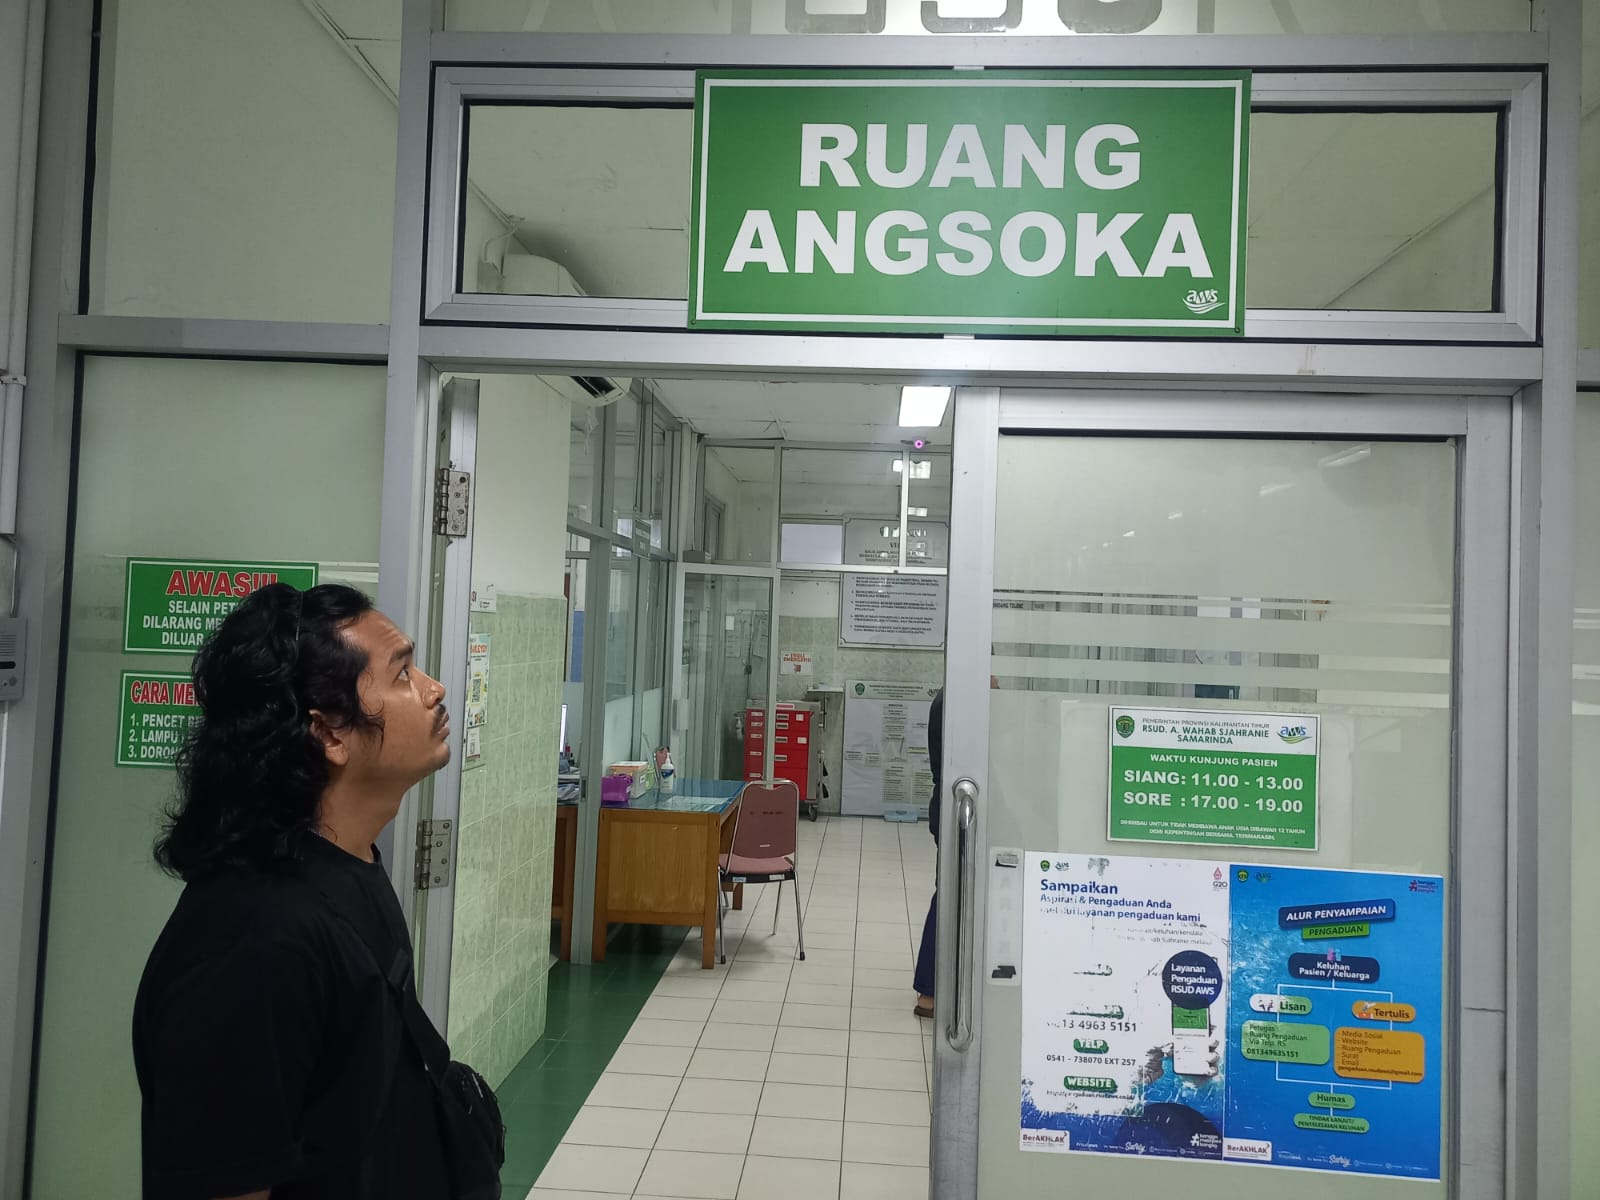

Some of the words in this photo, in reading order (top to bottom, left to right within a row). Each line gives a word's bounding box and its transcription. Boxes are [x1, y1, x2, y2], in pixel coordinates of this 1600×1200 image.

[799, 122, 1141, 190] RUANG
[722, 209, 1214, 279] ANGSOKA
[168, 600, 209, 615] SELAIN
[213, 602, 239, 615] PET
[143, 615, 201, 630] DILARANG
[205, 617, 223, 631] ME
[161, 632, 204, 646] DILUAR
[130, 680, 170, 705] CARA
[172, 682, 200, 707] ME
[130, 713, 140, 727] 1.
[142, 714, 185, 728] PENCET
[1142, 717, 1180, 725] PEMERINTAH
[1209, 720, 1250, 728] KALIMANTAN
[128, 729, 138, 742] 2.
[141, 730, 179, 744] LAMPU
[1142, 725, 1168, 733] RSUD.
[1170, 726, 1180, 734] A.
[1182, 726, 1217, 735] WAHAB
[1219, 728, 1270, 738] SJAHRANIE
[1177, 734, 1233, 744] SAMARINDA
[127, 745, 137, 758] 3.
[1150, 753, 1187, 763] WAKTU
[1190, 755, 1239, 766] KUNJUNG
[1242, 758, 1278, 767] PASIEN
[1123, 770, 1186, 785] SIANG:
[1191, 773, 1239, 787] 11.00
[1256, 777, 1303, 790] 13.00
[1123, 791, 1172, 806] SORE
[1191, 795, 1239, 810] 17.00
[1256, 798, 1303, 813] 19.00
[1040, 879, 1118, 895] Sampaikan
[1088, 896, 1144, 908] Pengaduan
[1146, 899, 1172, 909] Anda
[1117, 910, 1175, 921] pengaduan
[1176, 912, 1201, 922] kami
[1286, 910, 1313, 921] ALUR
[1314, 905, 1386, 919] PENYAMPAIAN
[1309, 924, 1364, 936] PENGADUAN
[1171, 963, 1206, 973] Layanan
[1316, 961, 1350, 971] Keluhan
[1171, 974, 1218, 985] Pengaduan
[1299, 967, 1326, 977] Pasien
[1333, 970, 1370, 980] Keluarga
[1171, 985, 1195, 994] RSUD
[1195, 986, 1215, 995] AWS
[1279, 1001, 1307, 1011] Lisan
[1374, 1007, 1410, 1018] Tertulis
[1078, 1020, 1106, 1030] 4963
[1110, 1022, 1137, 1032] 5151
[1249, 1023, 1275, 1032] Petugas
[1249, 1031, 1270, 1039] Ruang
[1271, 1033, 1308, 1041] Pengaduan
[1341, 1030, 1362, 1038] Media
[1079, 1039, 1104, 1049] TELP
[1341, 1044, 1363, 1053] Ruang
[1364, 1046, 1401, 1056] Pengaduan
[1046, 1054, 1065, 1062] 0541
[1073, 1056, 1102, 1065] 738070
[1104, 1057, 1119, 1065] EXT
[1121, 1058, 1136, 1066] 257
[1341, 1051, 1359, 1059] Surat
[1067, 1077, 1112, 1088] WEBSITE
[1316, 1093, 1346, 1103] Humas
